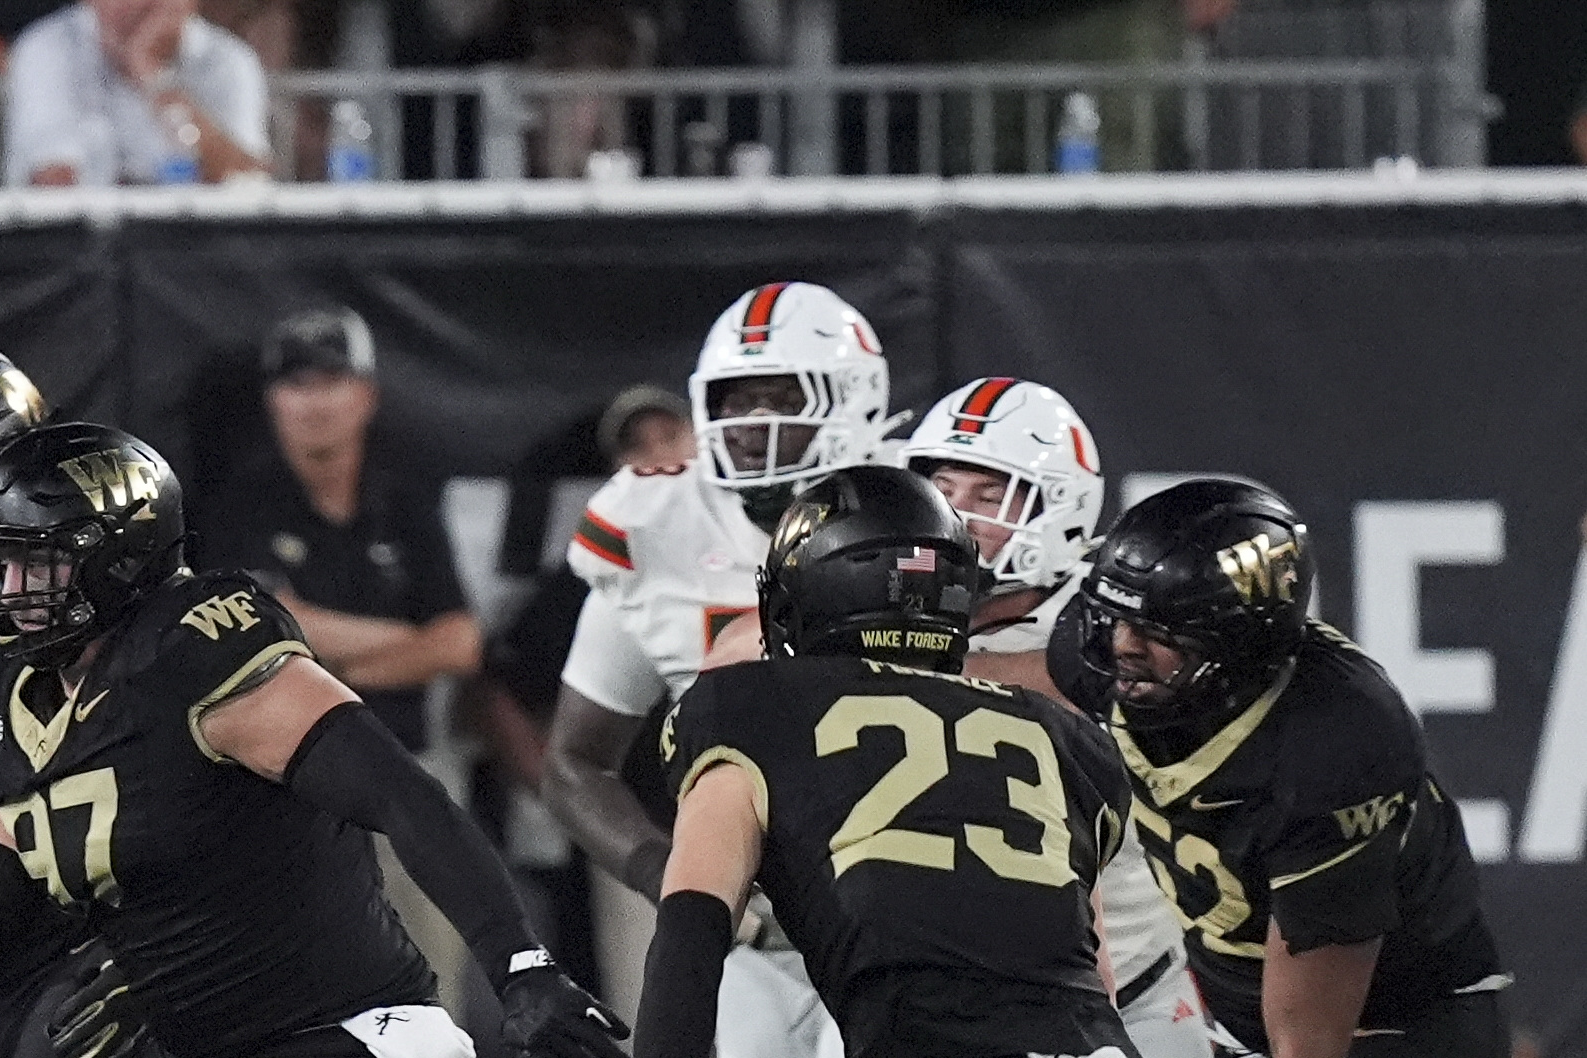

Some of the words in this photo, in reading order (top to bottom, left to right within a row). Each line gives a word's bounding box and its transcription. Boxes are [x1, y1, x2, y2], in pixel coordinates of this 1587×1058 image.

[179, 590, 261, 641] WF
[861, 630, 901, 648] WAKE
[906, 631, 953, 651] FOREST
[815, 695, 1079, 888] 23
